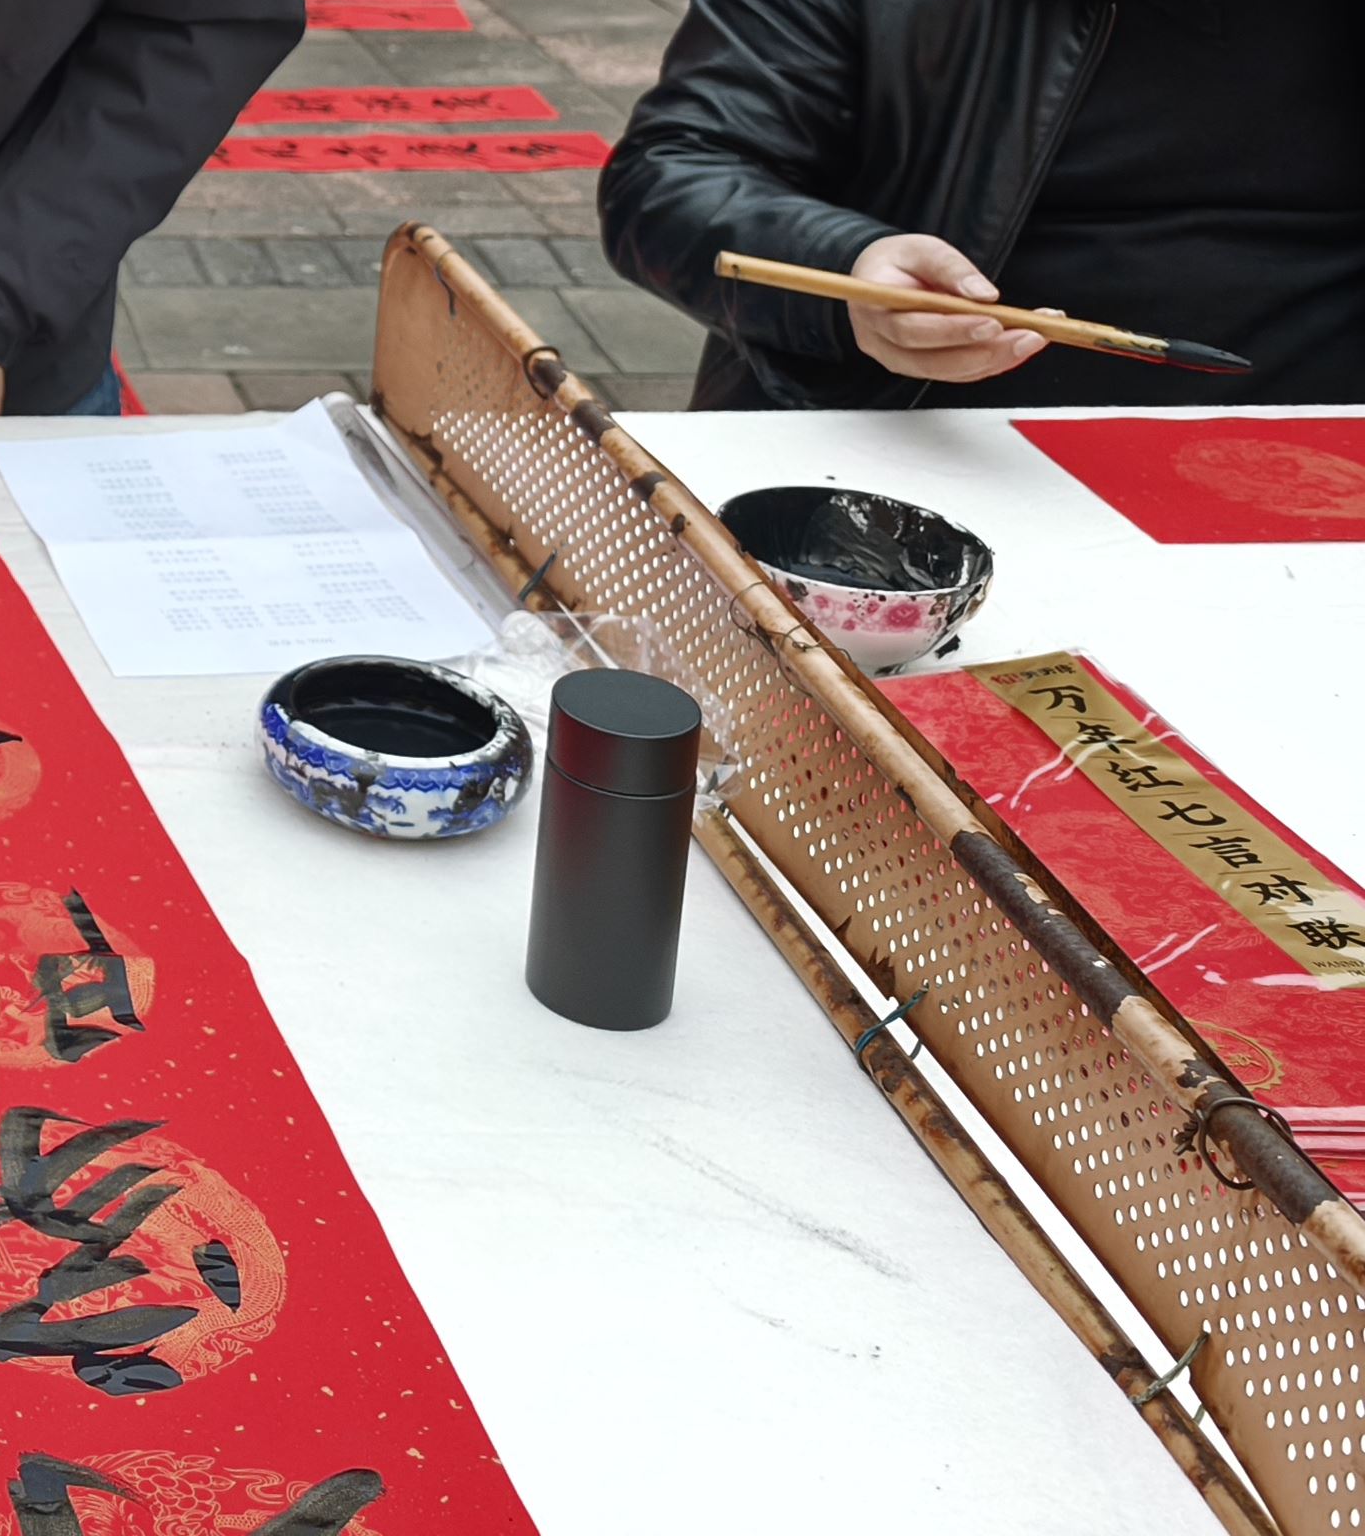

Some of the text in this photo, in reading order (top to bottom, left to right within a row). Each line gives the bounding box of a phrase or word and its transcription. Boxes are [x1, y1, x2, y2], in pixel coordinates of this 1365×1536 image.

[1026, 684, 1365, 951] 万年红七言对联
